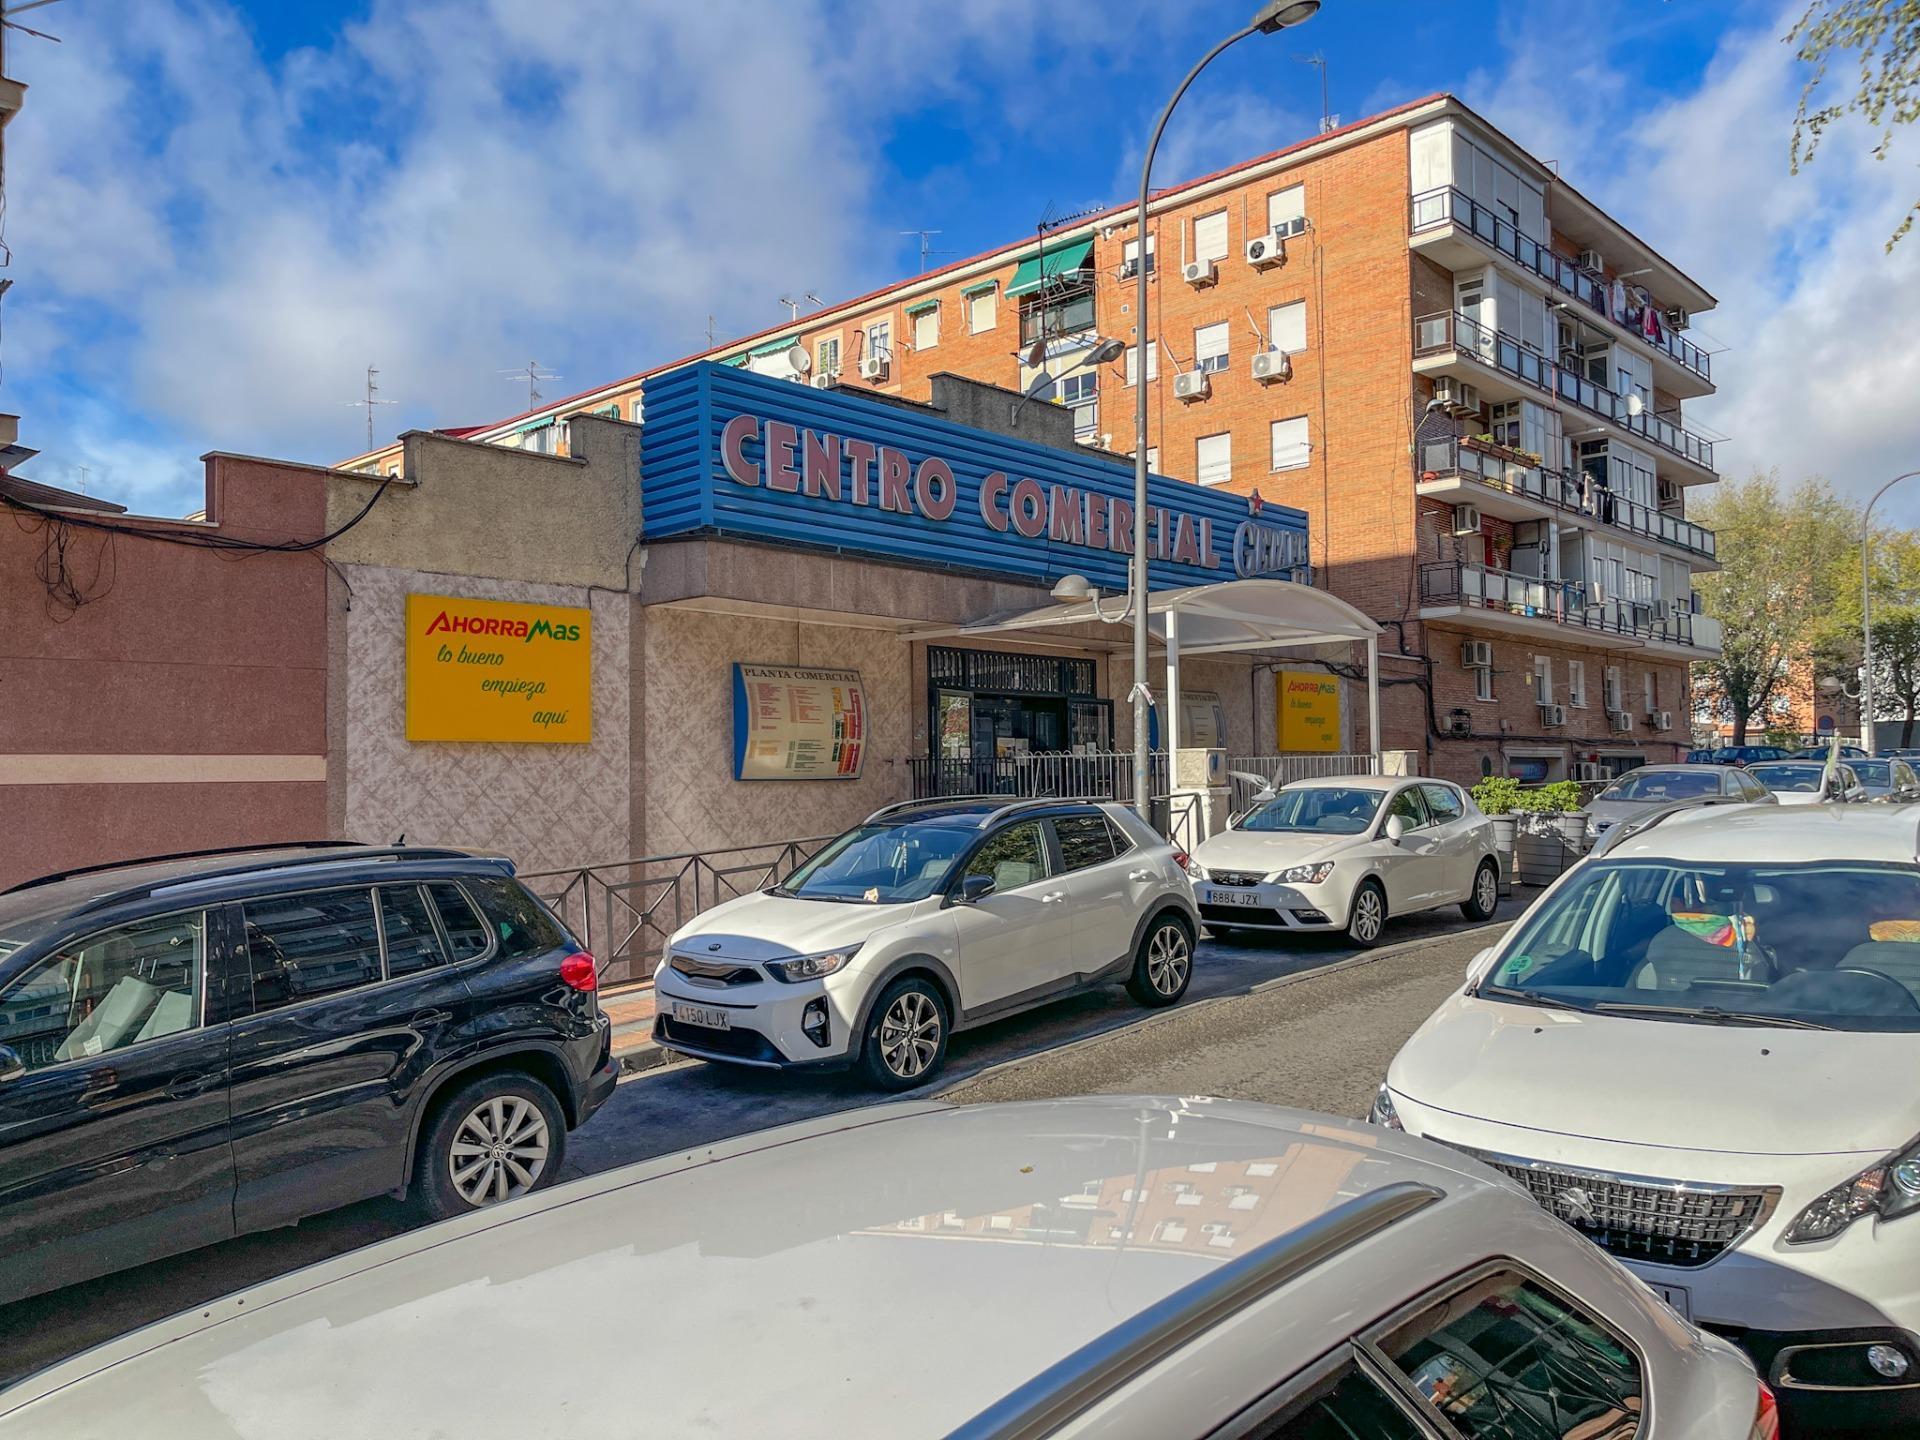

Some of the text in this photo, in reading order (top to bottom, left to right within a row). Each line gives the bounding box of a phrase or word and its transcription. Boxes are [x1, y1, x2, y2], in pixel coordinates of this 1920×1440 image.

[721, 414, 957, 521] CENTRO
[437, 643, 504, 666] lo bueno
[744, 668, 858, 682] PLANTA COMERCIAL
[481, 678, 547, 700] empieza
[532, 709, 569, 728] aquí
[1212, 892, 1258, 905] 6884 JZX
[679, 1005, 727, 1028] 4150 LJX
